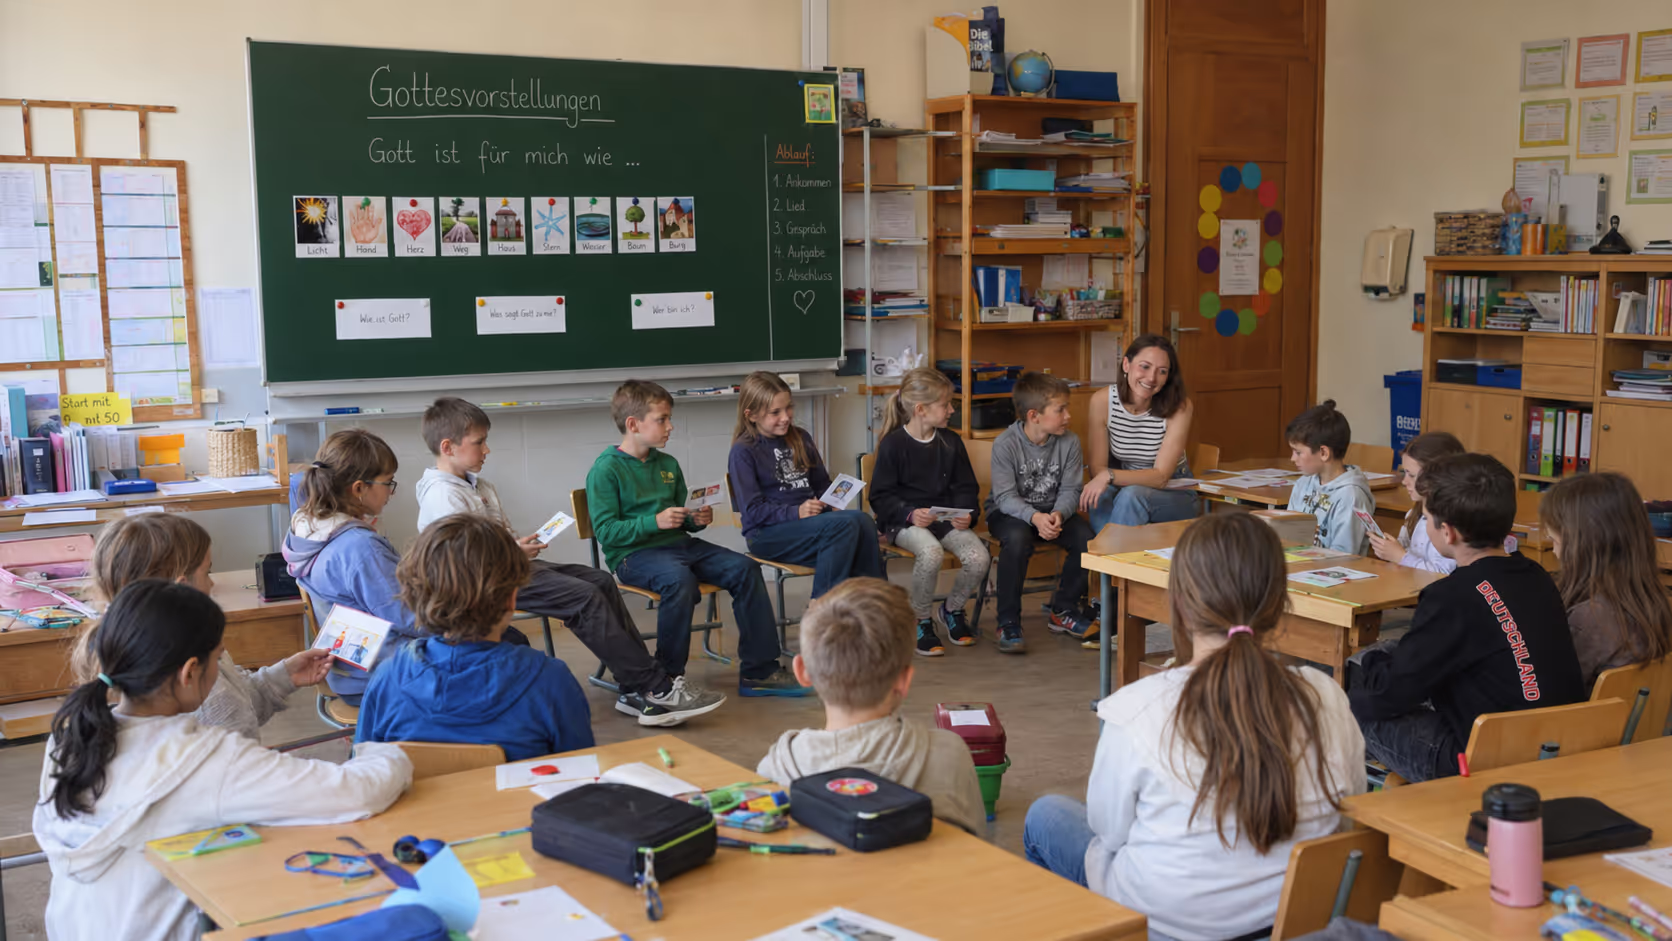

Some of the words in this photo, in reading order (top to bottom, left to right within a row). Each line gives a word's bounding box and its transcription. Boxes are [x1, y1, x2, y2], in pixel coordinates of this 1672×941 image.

[969, 28, 989, 40] Die
[369, 64, 601, 128] Gottesvorstellungen
[368, 137, 416, 163] Gott
[435, 141, 460, 163] ist
[478, 141, 509, 174] für
[525, 142, 569, 165] mich
[584, 146, 613, 166] wie
[775, 143, 815, 168] Ablauf:
[773, 174, 783, 188] 1.
[785, 173, 832, 188] Ankommen
[773, 198, 783, 212] 2.
[786, 199, 806, 212] Lied
[773, 221, 784, 235] 3.
[786, 221, 827, 239] Gespräch
[307, 246, 328, 255] Licht
[356, 245, 377, 254] Hand
[406, 245, 425, 254] Herz
[453, 244, 470, 256] Weg
[498, 243, 516, 252] Haus
[543, 242, 561, 252] Stern
[627, 241, 647, 250] Baum
[669, 240, 687, 250] Burg
[774, 245, 785, 259] 4.
[787, 244, 826, 264] Aufgabe
[775, 268, 785, 282] 5.
[787, 268, 833, 282] Abschluss
[520, 308, 534, 318] Gott
[652, 305, 665, 315] Wer
[667, 305, 678, 314] bin
[680, 303, 696, 314] ich?
[360, 312, 373, 324] Wie
[388, 312, 411, 324] Gott?
[62, 397, 89, 409] Start
[92, 396, 112, 407] mit
[104, 411, 120, 424] 50
[1475, 579, 1541, 702] DEUTSCHLAND
